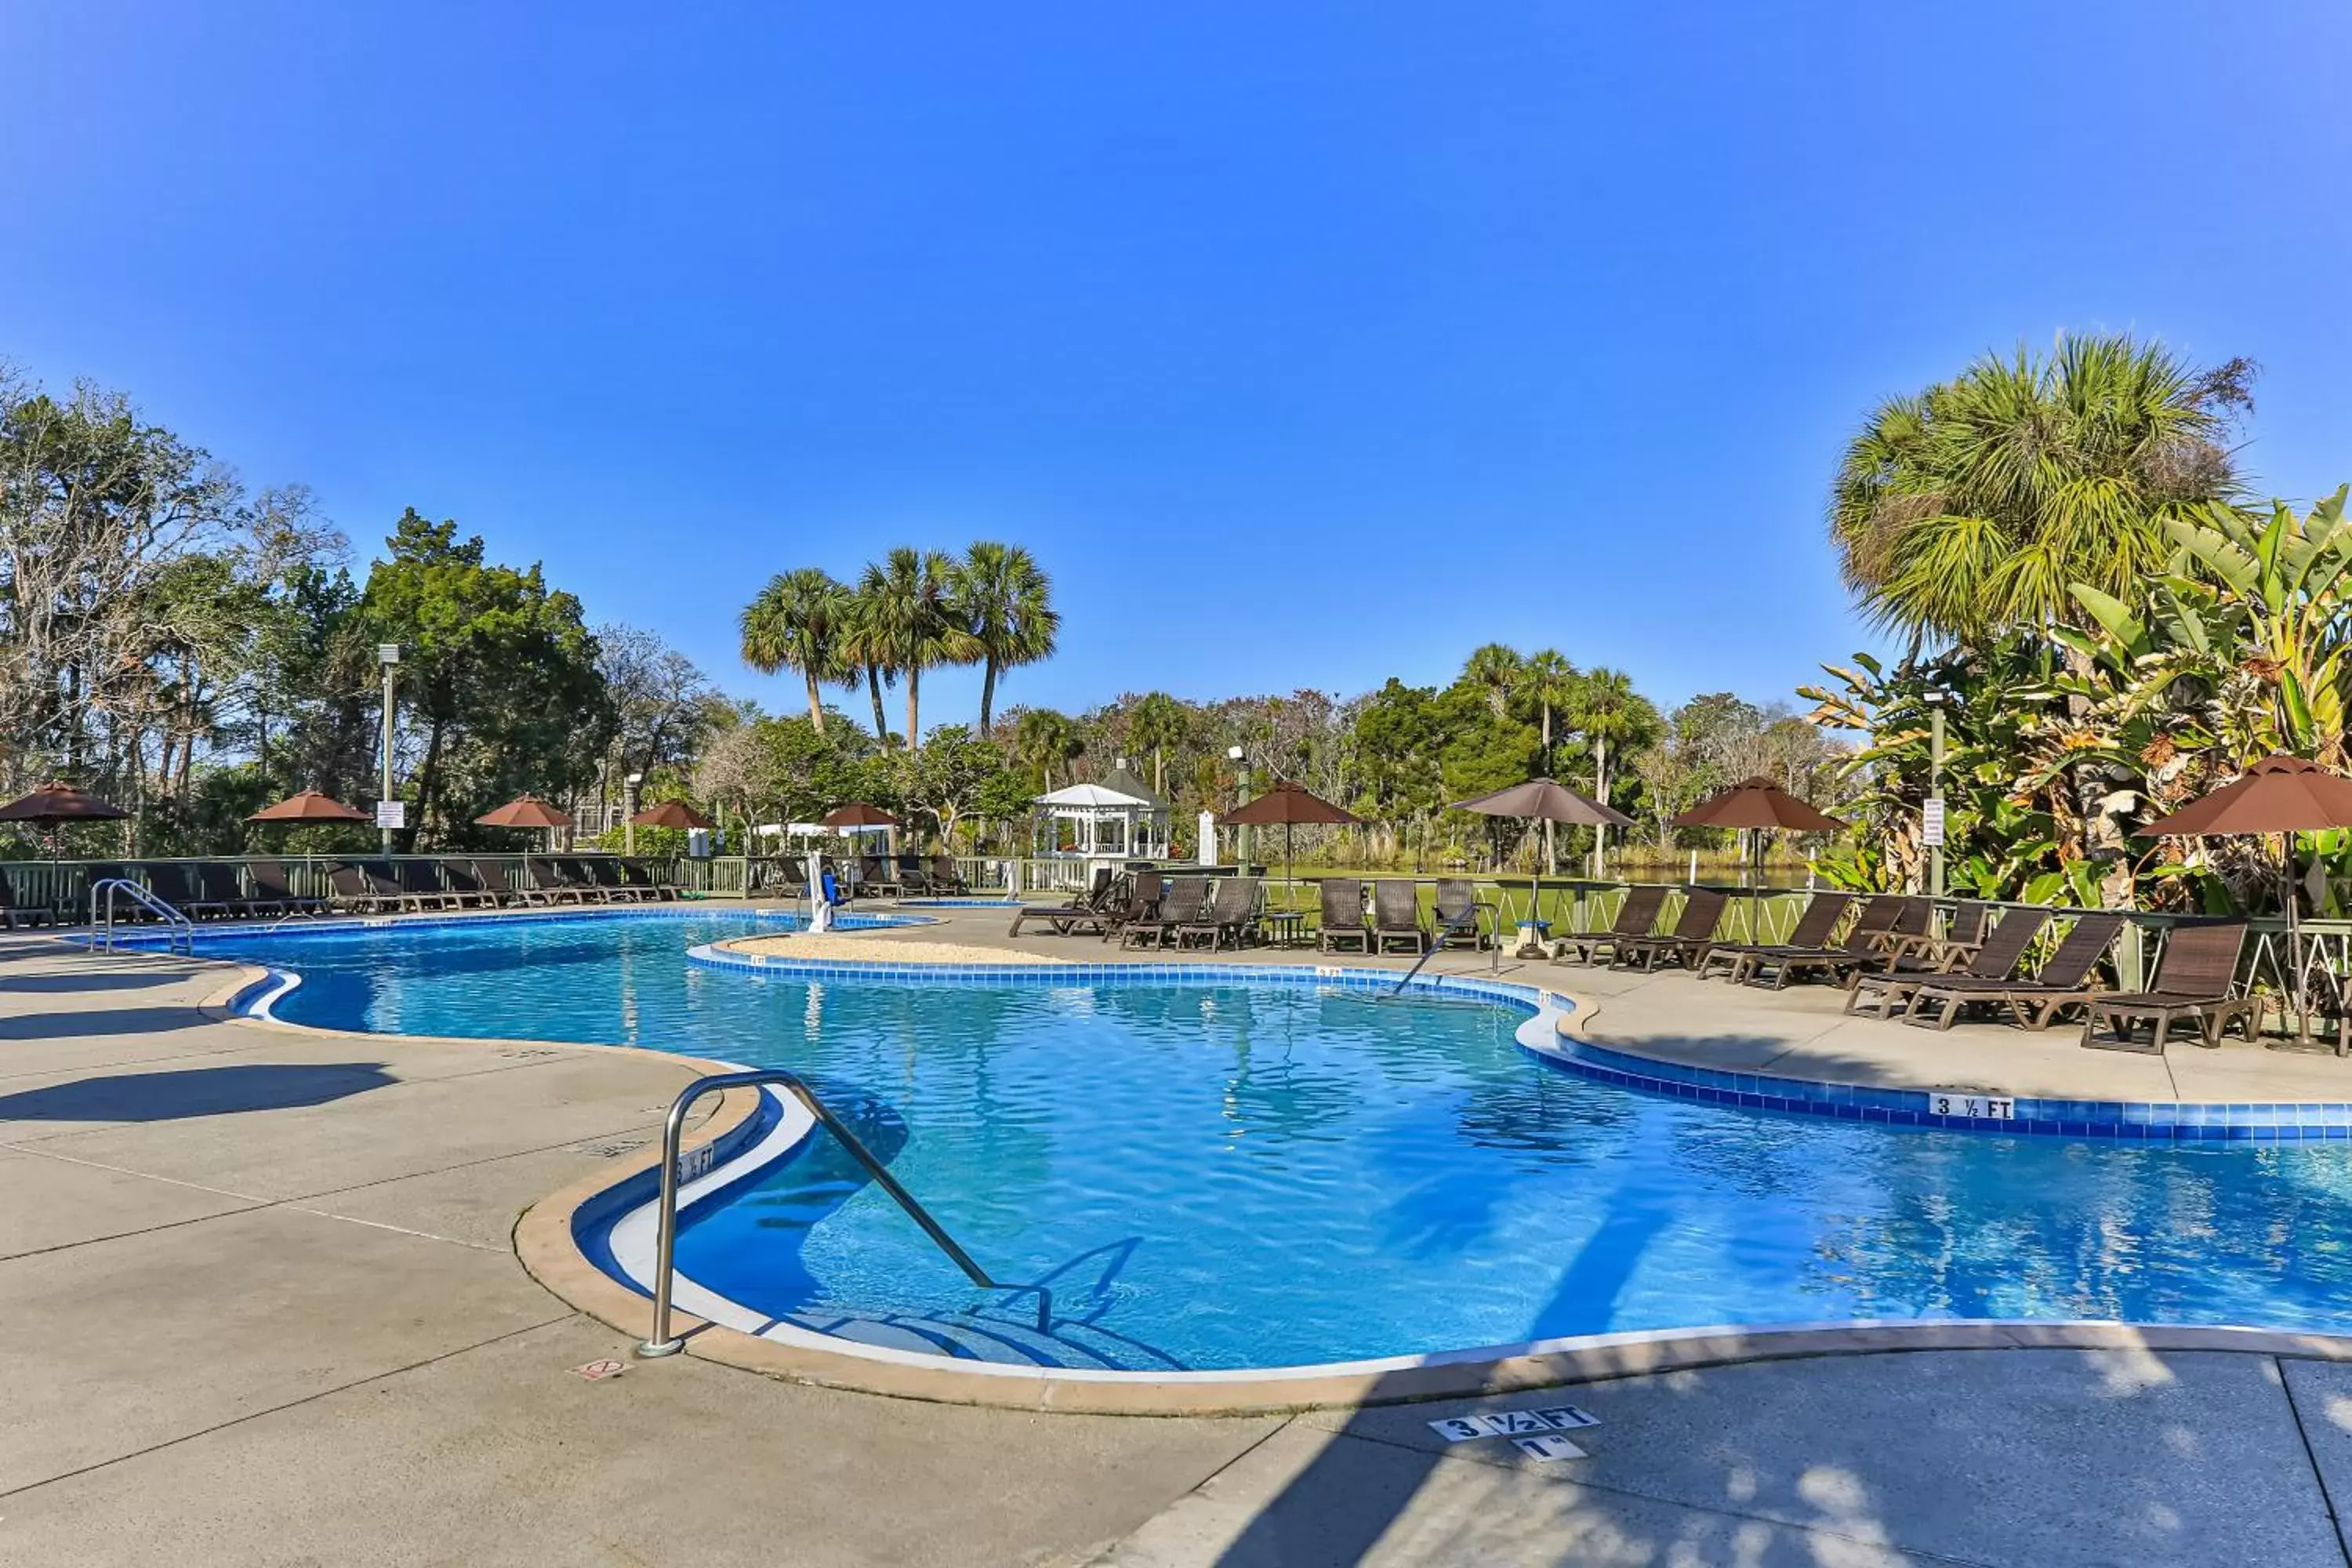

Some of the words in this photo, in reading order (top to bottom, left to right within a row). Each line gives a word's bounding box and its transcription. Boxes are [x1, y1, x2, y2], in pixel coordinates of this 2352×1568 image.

[1937, 1098, 1950, 1114] 3
[1987, 1100, 2011, 1119] FT
[1446, 1419, 1480, 1437] 3
[1536, 1406, 1590, 1428] FT
